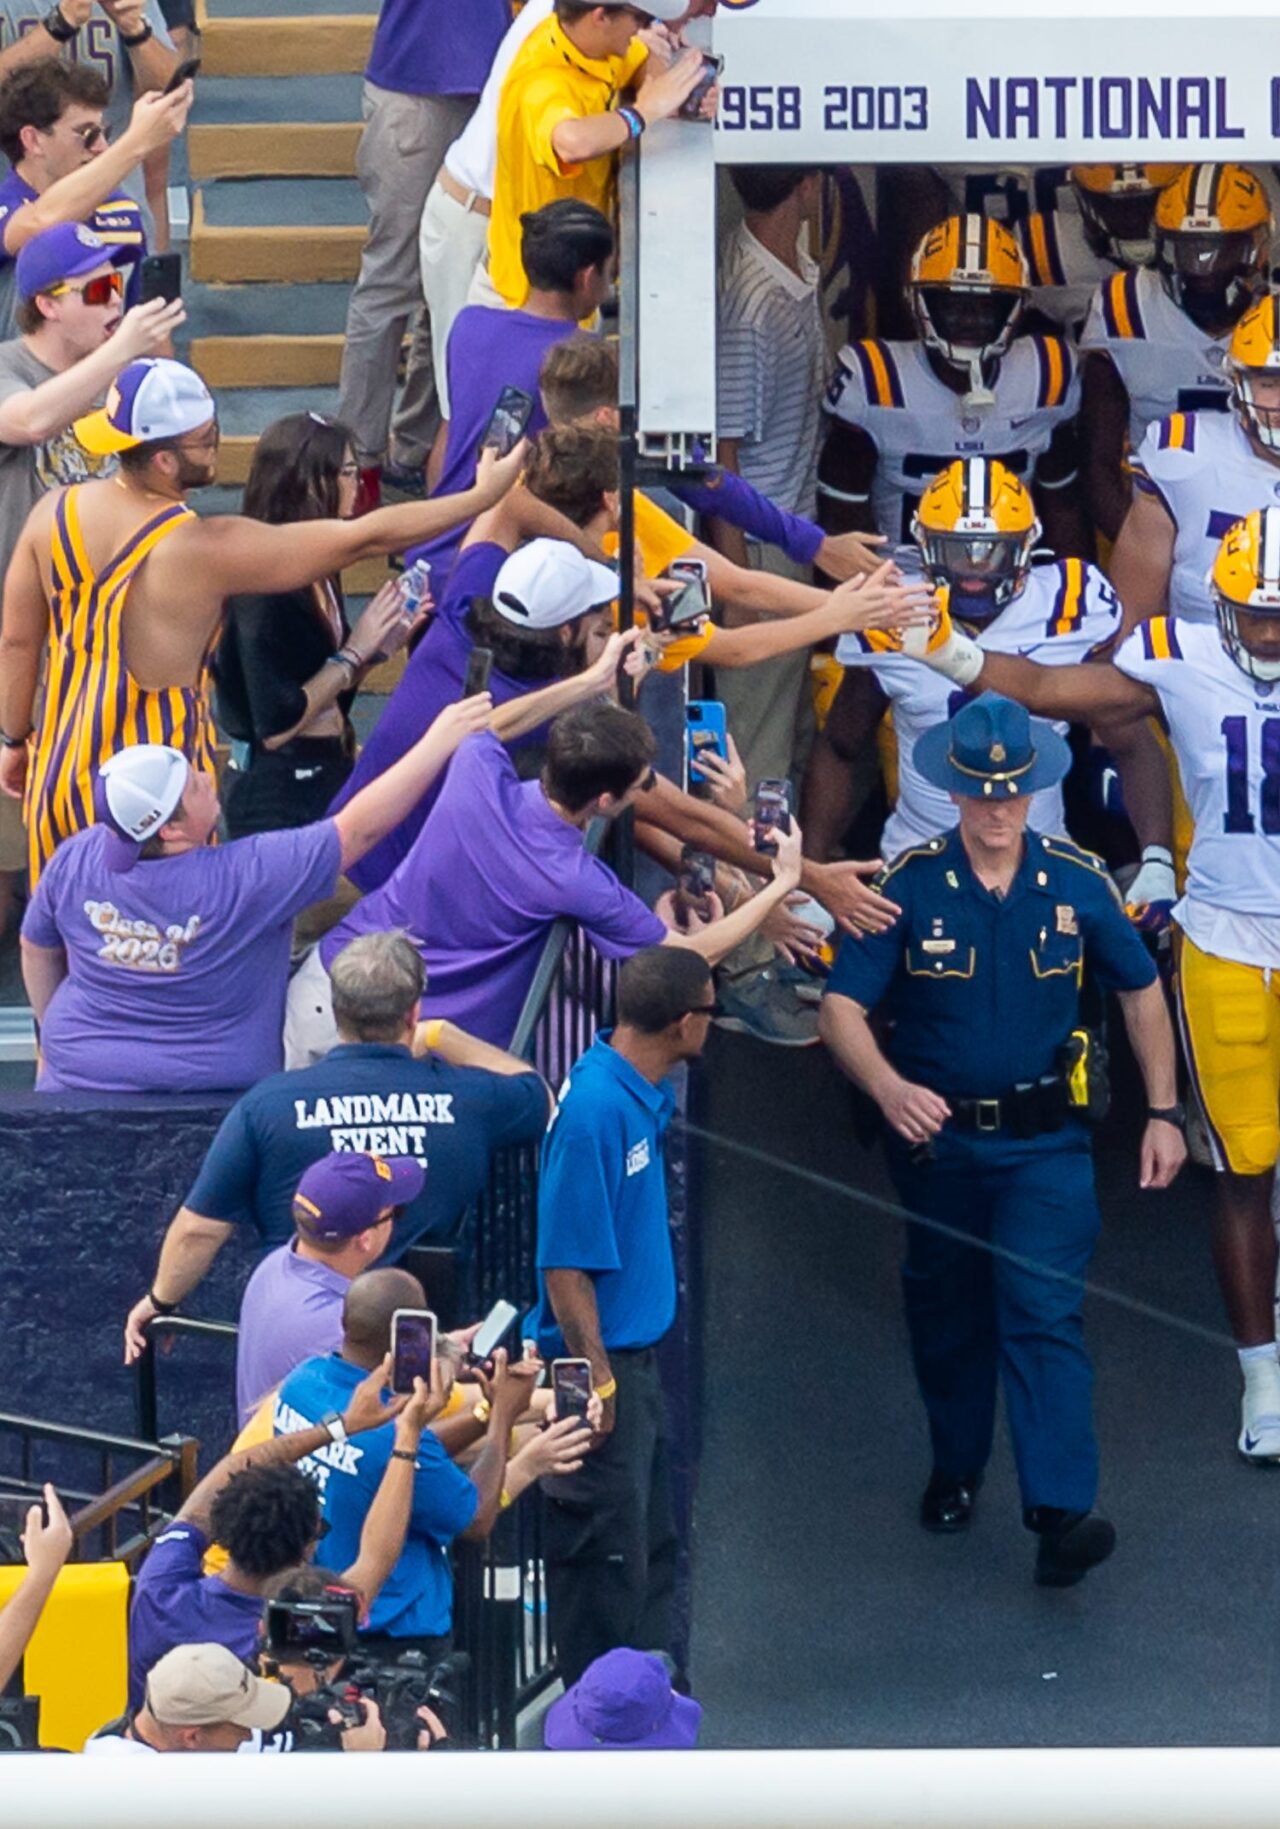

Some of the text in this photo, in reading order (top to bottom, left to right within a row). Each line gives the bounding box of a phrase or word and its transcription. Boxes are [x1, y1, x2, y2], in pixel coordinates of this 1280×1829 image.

[715, 86, 801, 130] 958
[824, 86, 928, 130] 2003
[966, 77, 1245, 139] NATIONAL
[83, 900, 161, 941] Class
[97, 932, 181, 973] 2026
[294, 1093, 455, 1129] LANDMARK
[330, 1126, 427, 1155] EVENT
